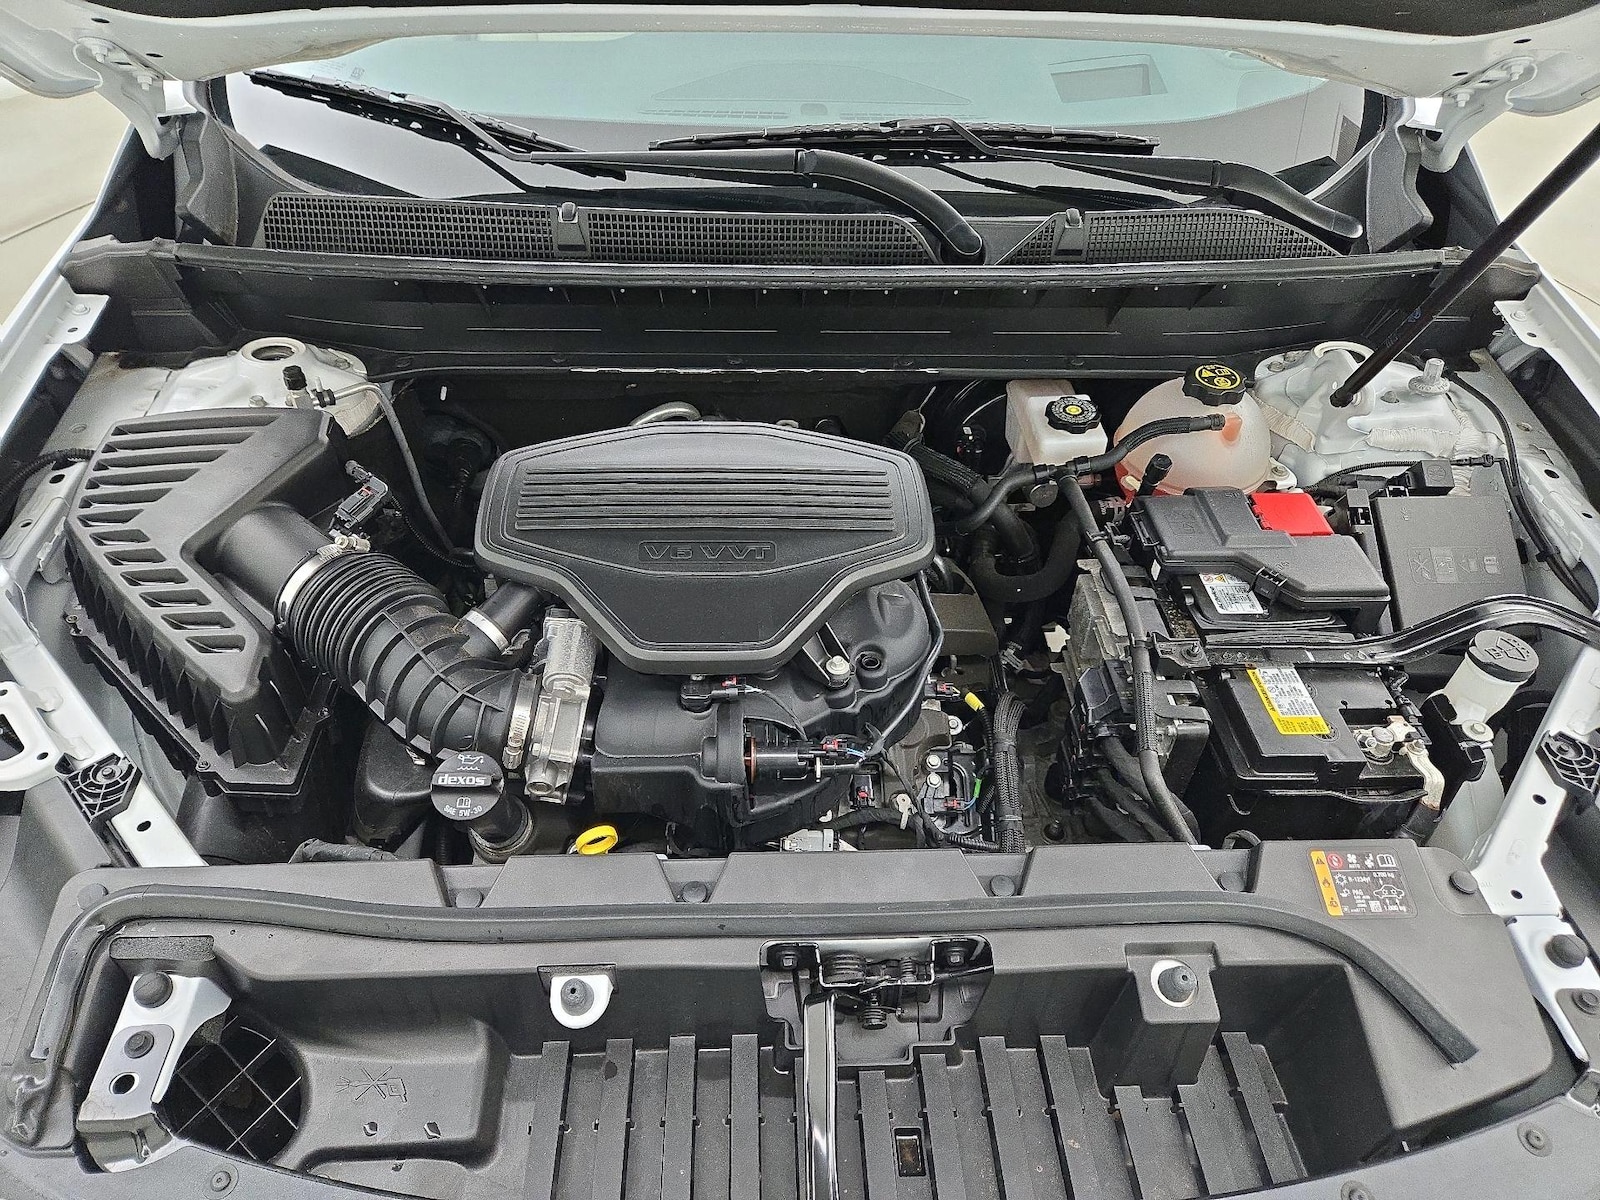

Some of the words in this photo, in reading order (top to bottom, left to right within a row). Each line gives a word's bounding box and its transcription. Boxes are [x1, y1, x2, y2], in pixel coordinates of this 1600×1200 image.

[643, 544, 693, 559] V6
[699, 544, 771, 559] VVT
[437, 773, 487, 785] dexos
[443, 804, 457, 816] SAE
[458, 805, 483, 817] 5W-30
